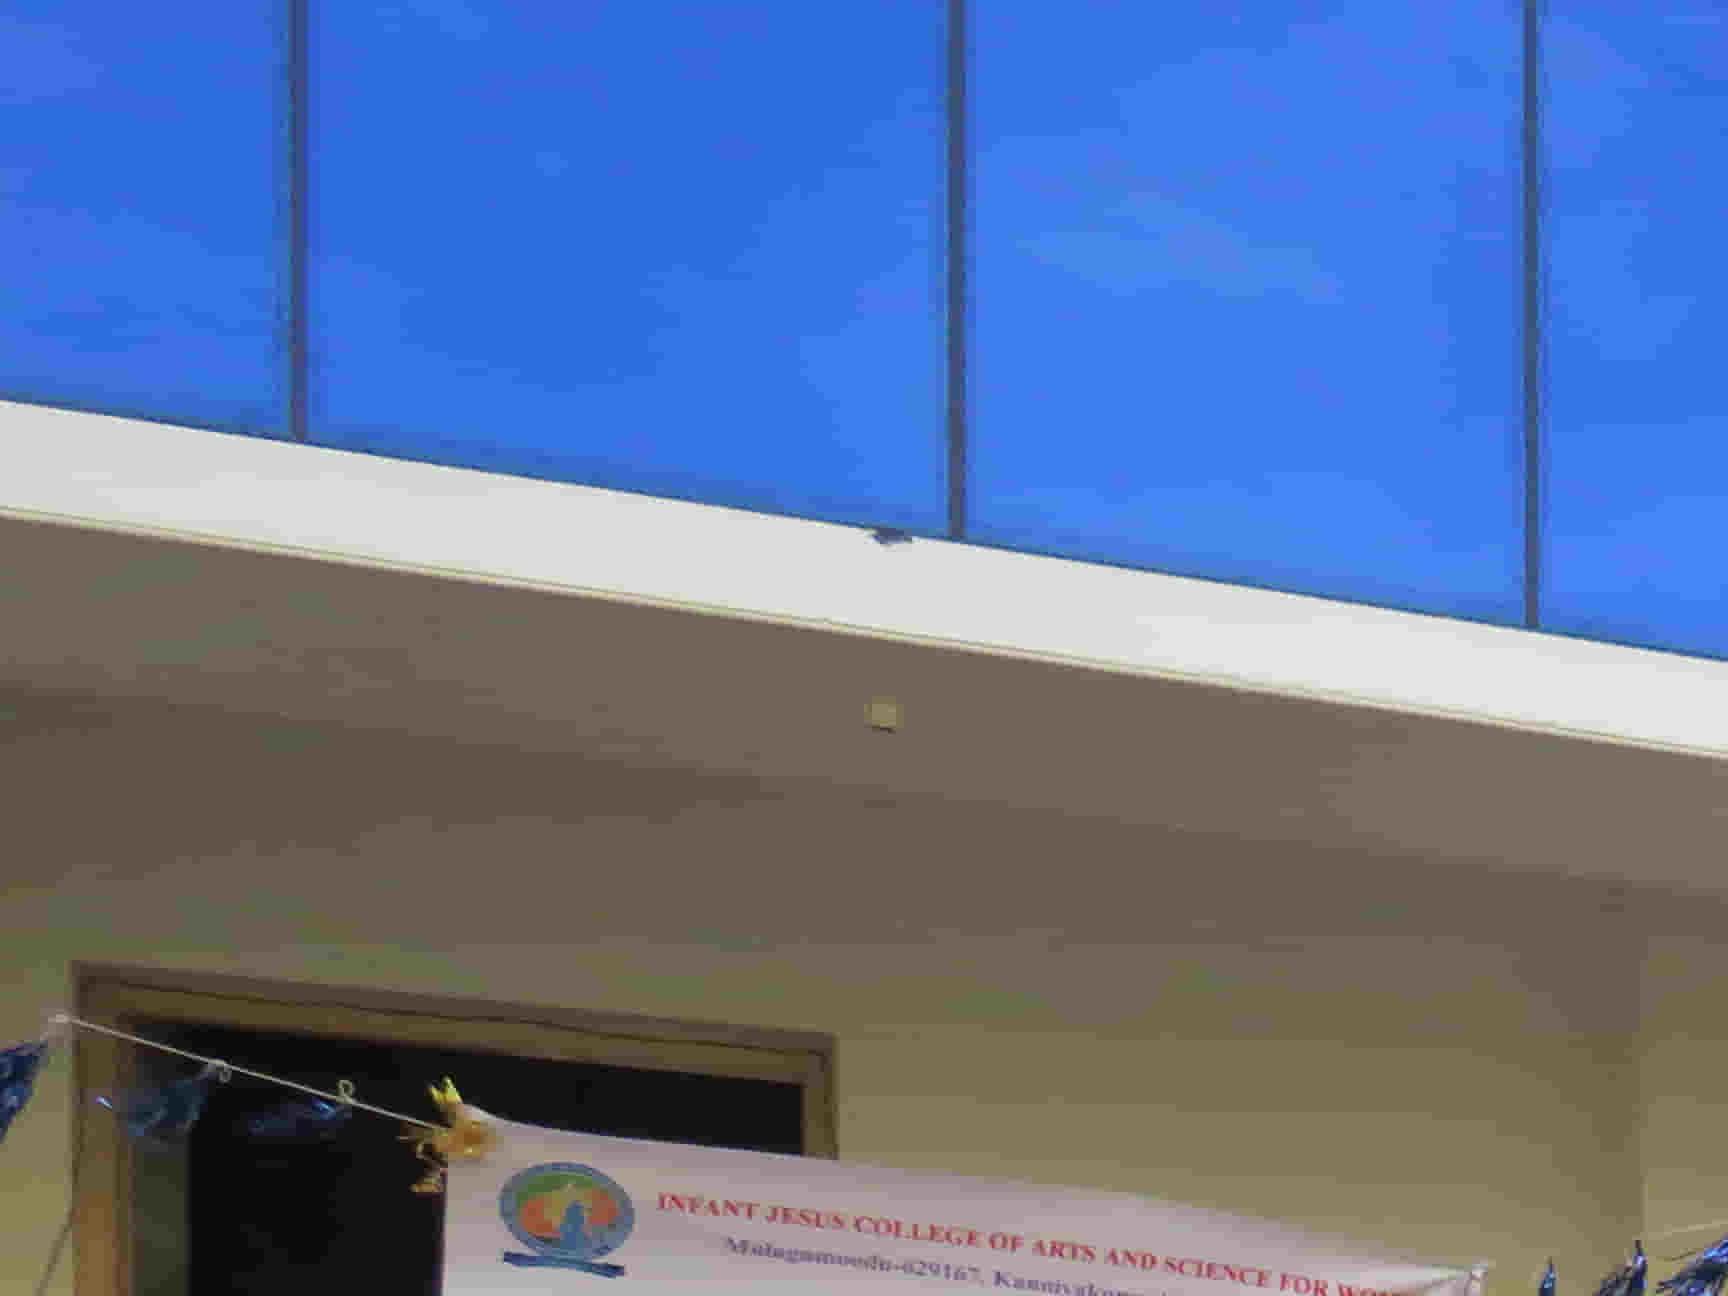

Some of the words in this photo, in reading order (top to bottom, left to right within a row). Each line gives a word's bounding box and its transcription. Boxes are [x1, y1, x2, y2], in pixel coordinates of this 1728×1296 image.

[656, 1191, 760, 1221] INFANT
[765, 1206, 846, 1230] JESUS
[852, 1215, 986, 1248] COLLEGE
[989, 1231, 1024, 1253] OF
[1032, 1239, 1097, 1264] ARTS
[1104, 1249, 1158, 1271] AND
[1163, 1256, 1272, 1288] SCIENCE
